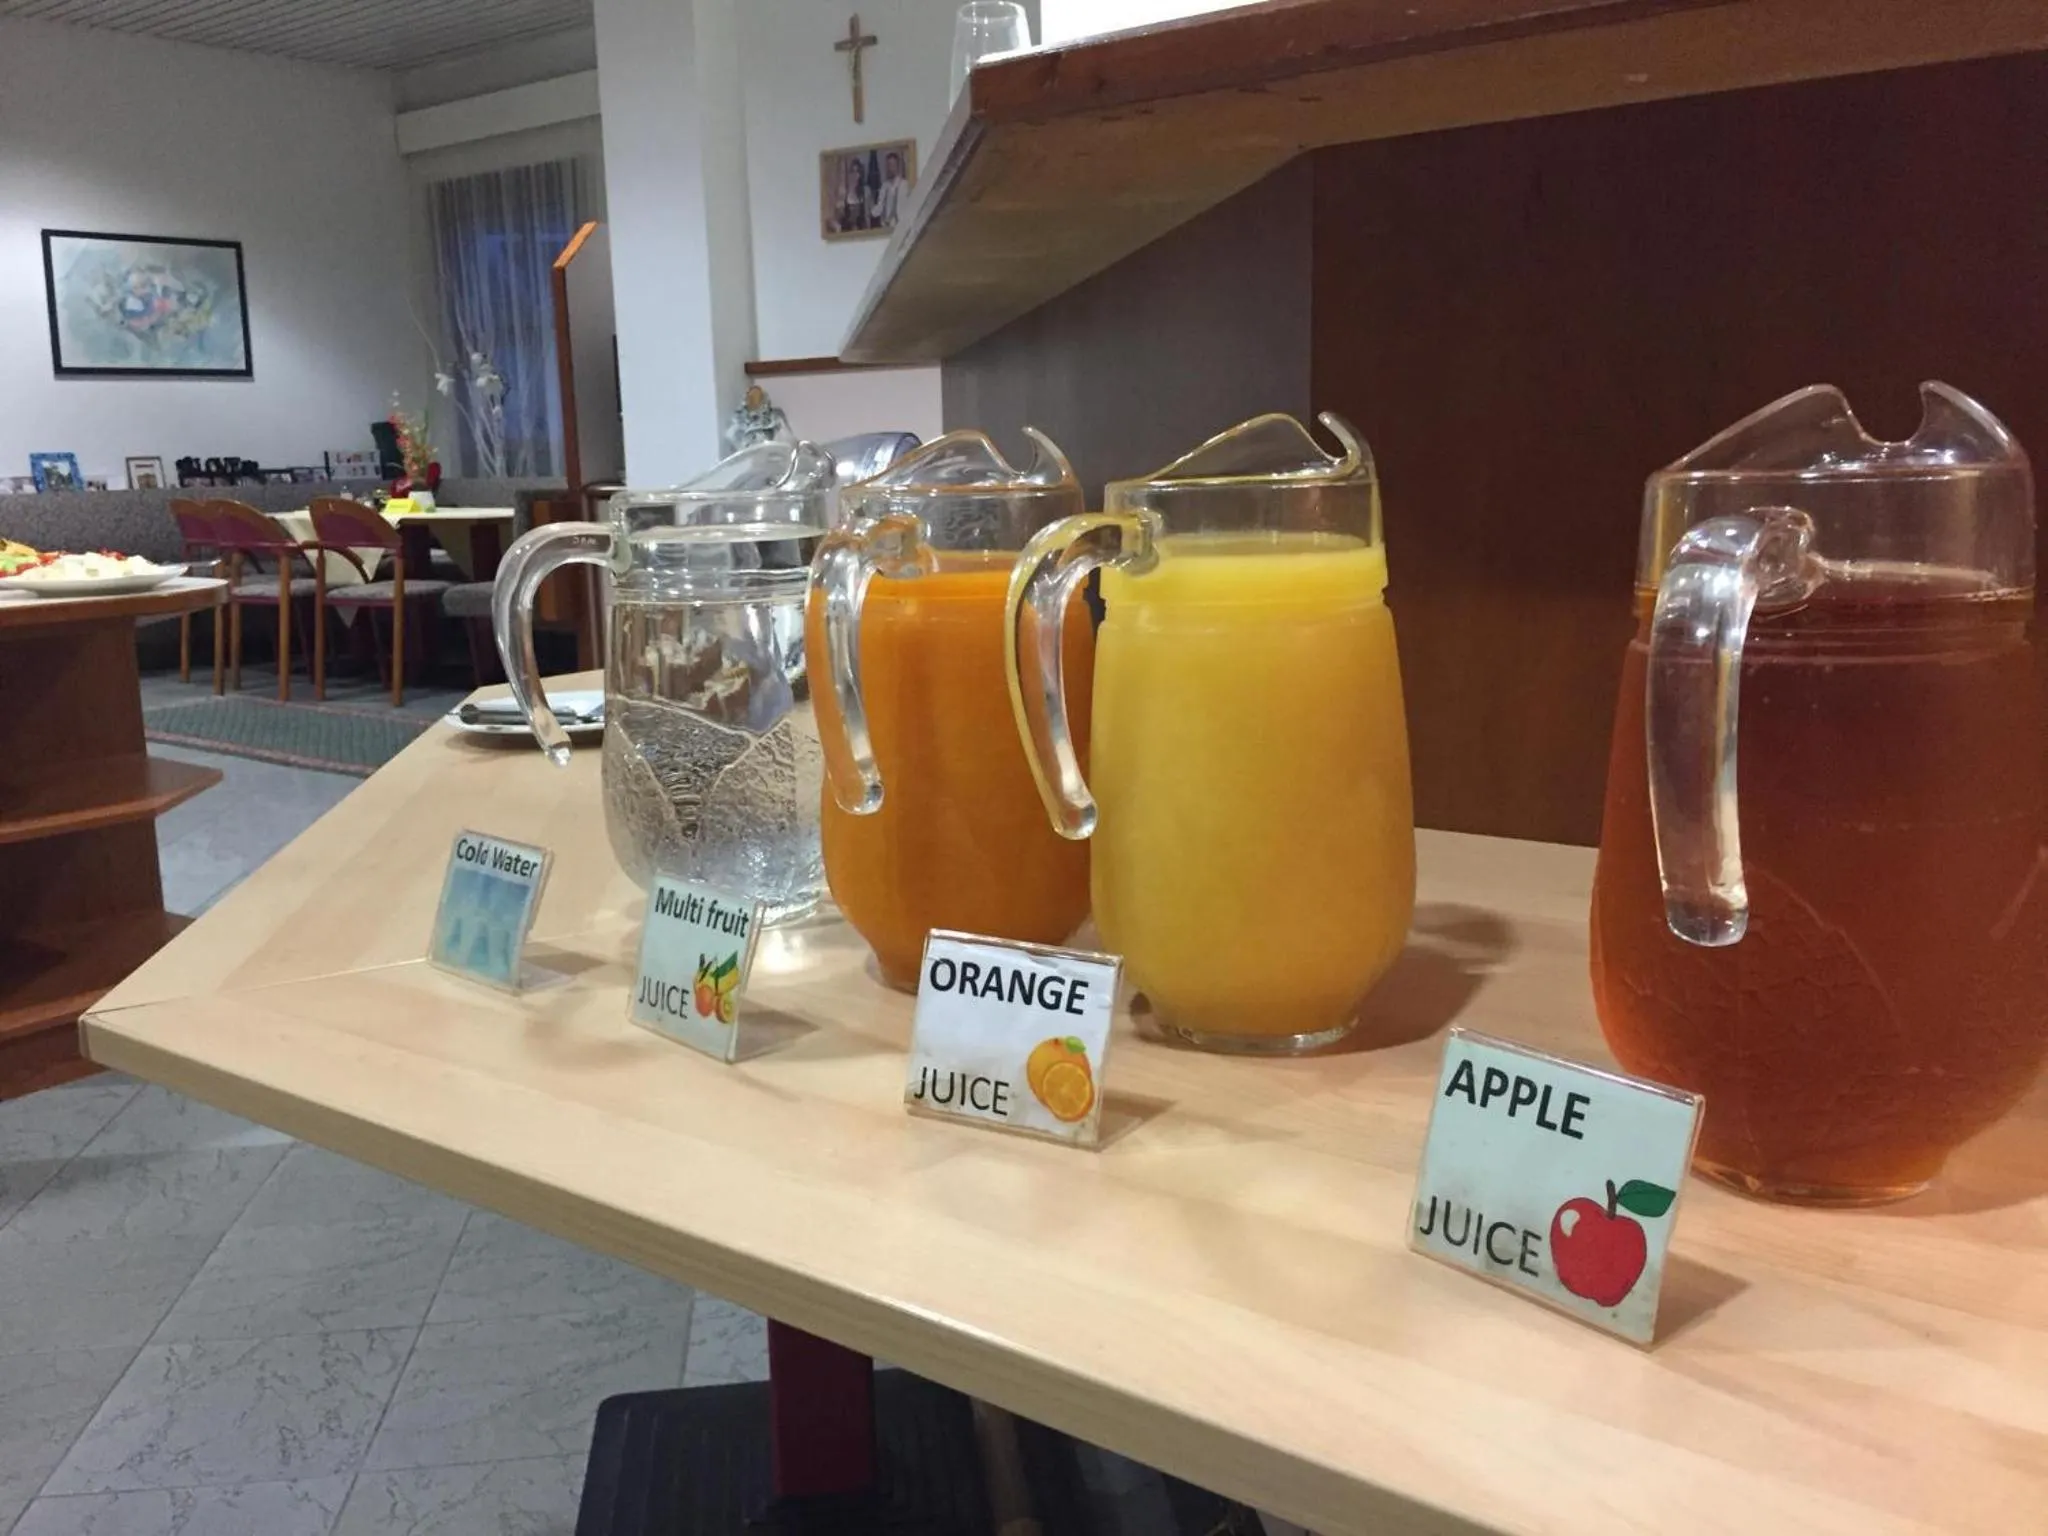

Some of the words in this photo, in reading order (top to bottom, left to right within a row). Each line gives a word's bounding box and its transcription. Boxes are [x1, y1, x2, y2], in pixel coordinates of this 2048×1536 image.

[456, 838, 489, 865] Cold
[492, 848, 539, 879] Water
[655, 887, 703, 925] Multi
[706, 899, 749, 937] fruit
[638, 975, 690, 1019] JUICE
[930, 958, 1089, 1015] ORANGE
[914, 1066, 1010, 1116] JUICE
[1445, 1059, 1591, 1139] APPLE
[1419, 1196, 1542, 1277] JUICE
